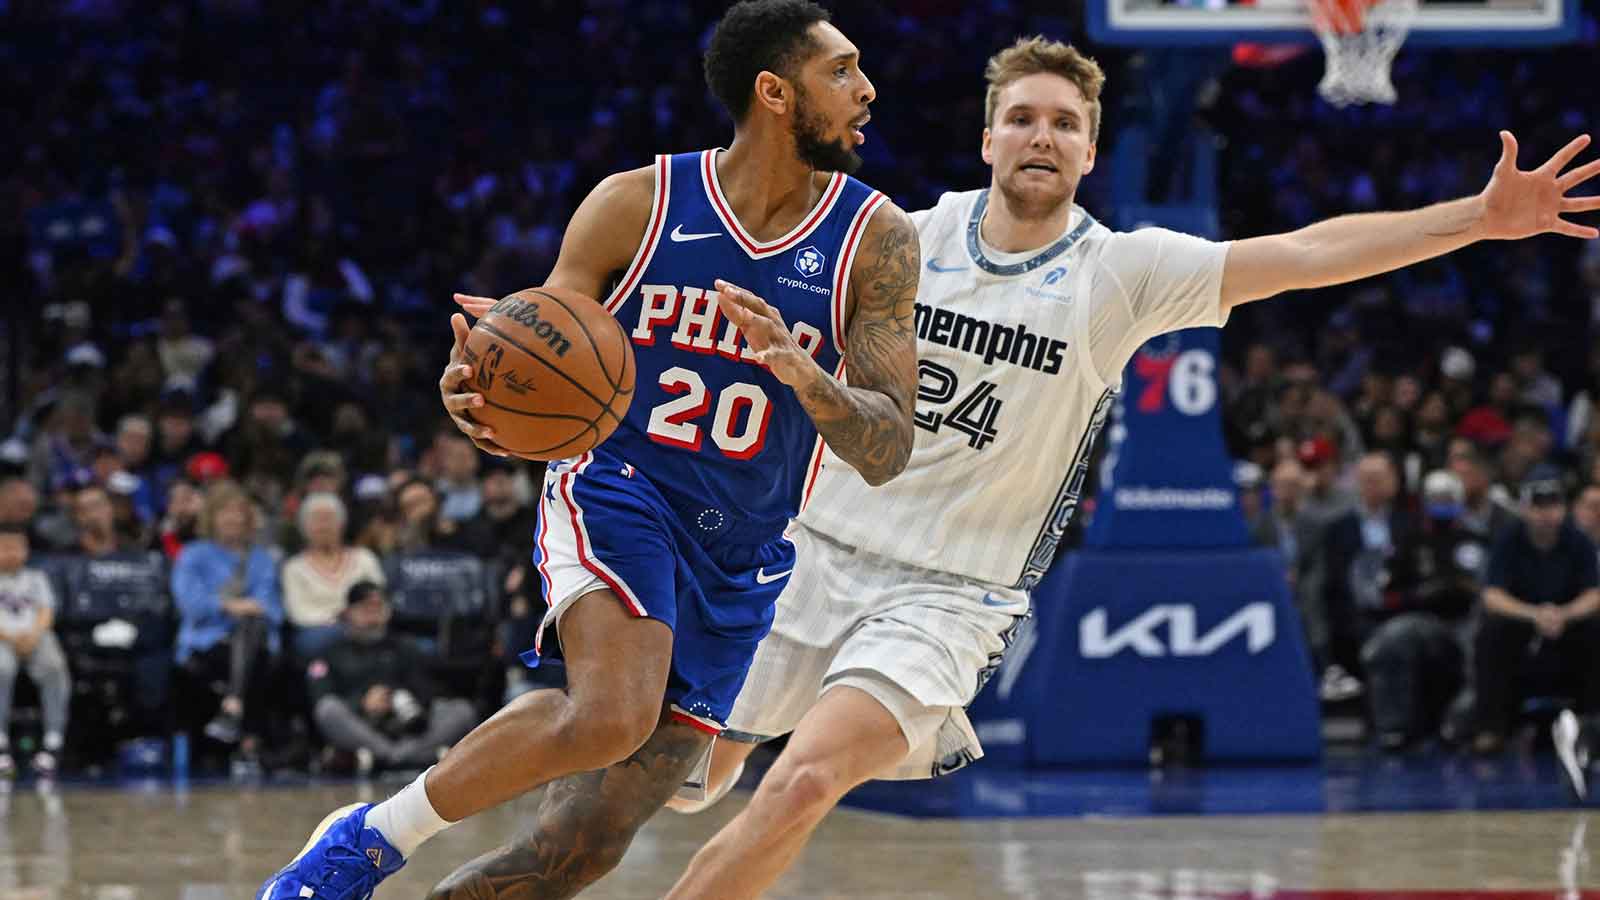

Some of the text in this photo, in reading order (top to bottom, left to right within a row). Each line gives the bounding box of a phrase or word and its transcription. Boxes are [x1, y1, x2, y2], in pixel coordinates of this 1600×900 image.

[777, 276, 830, 296] crypto.com
[488, 297, 571, 357] Wilson
[646, 366, 773, 460] 20
[914, 359, 1003, 450] 24
[1134, 348, 1217, 416] 76
[1080, 602, 1275, 658] KIA
